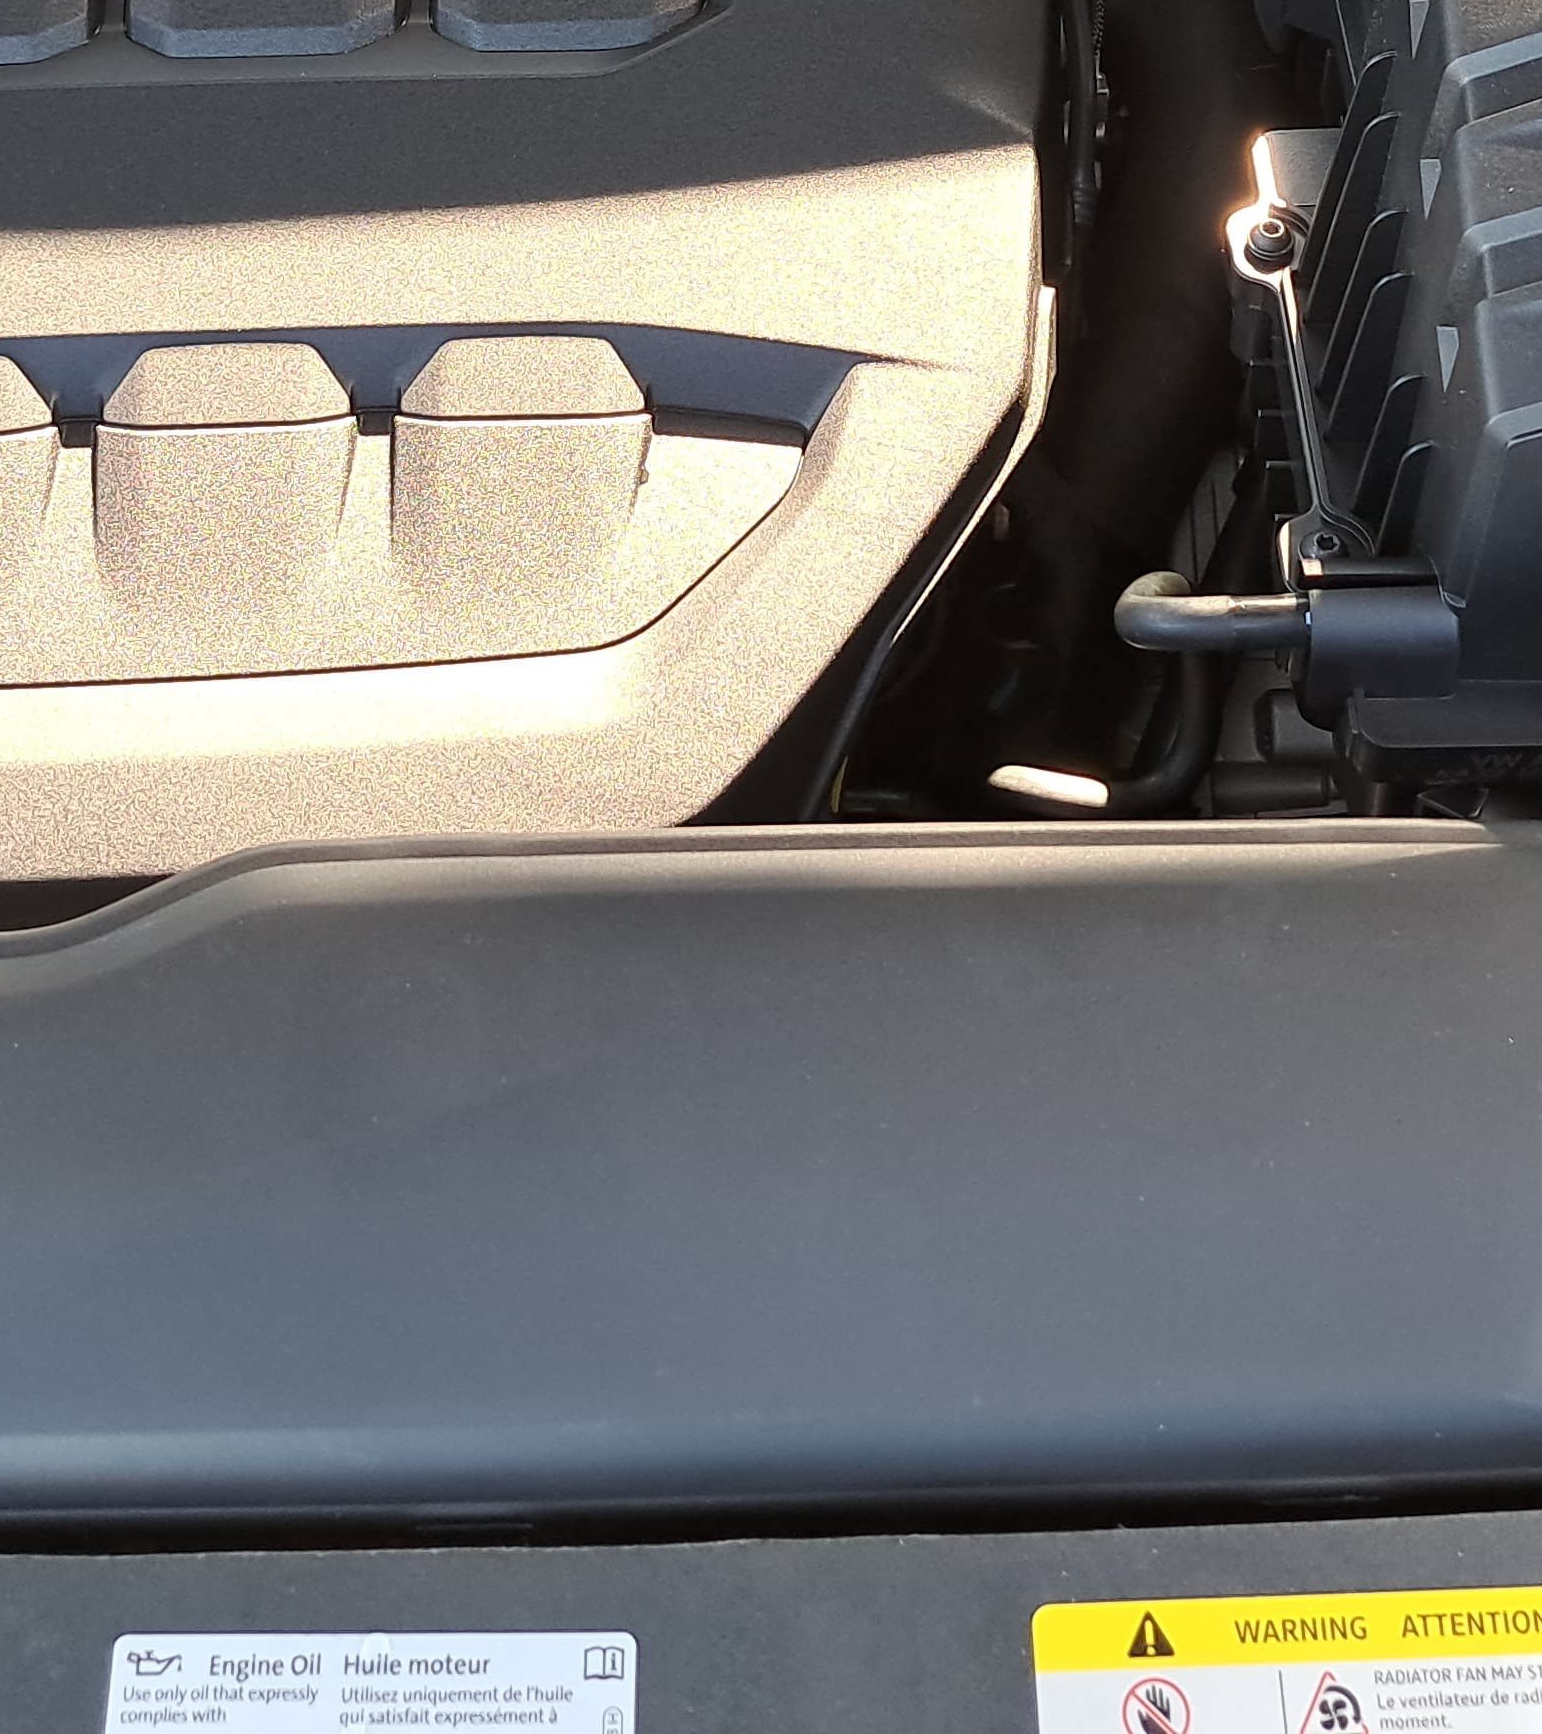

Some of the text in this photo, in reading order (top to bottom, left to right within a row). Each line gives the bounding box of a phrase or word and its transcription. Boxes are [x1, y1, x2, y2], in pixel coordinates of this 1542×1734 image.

[1235, 1616, 1367, 1644] WARNING
[210, 1653, 322, 1683] Engine Oil
[344, 1653, 491, 1676] Huile moteur
[1374, 1667, 1451, 1685] RADIATOR
[1456, 1666, 1487, 1682] FAN
[1492, 1665, 1523, 1681] MAY
[123, 1685, 319, 1706] Use only oil that expressly
[341, 1685, 574, 1707] Utilisez uniquement de l'huile
[1377, 1694, 1394, 1710] Le
[1399, 1692, 1484, 1709] ventilateur
[1491, 1689, 1509, 1705] de
[120, 1706, 226, 1726] complies with
[339, 1707, 558, 1728] qui satisfait expressément à
[1379, 1714, 1453, 1731] moment.
